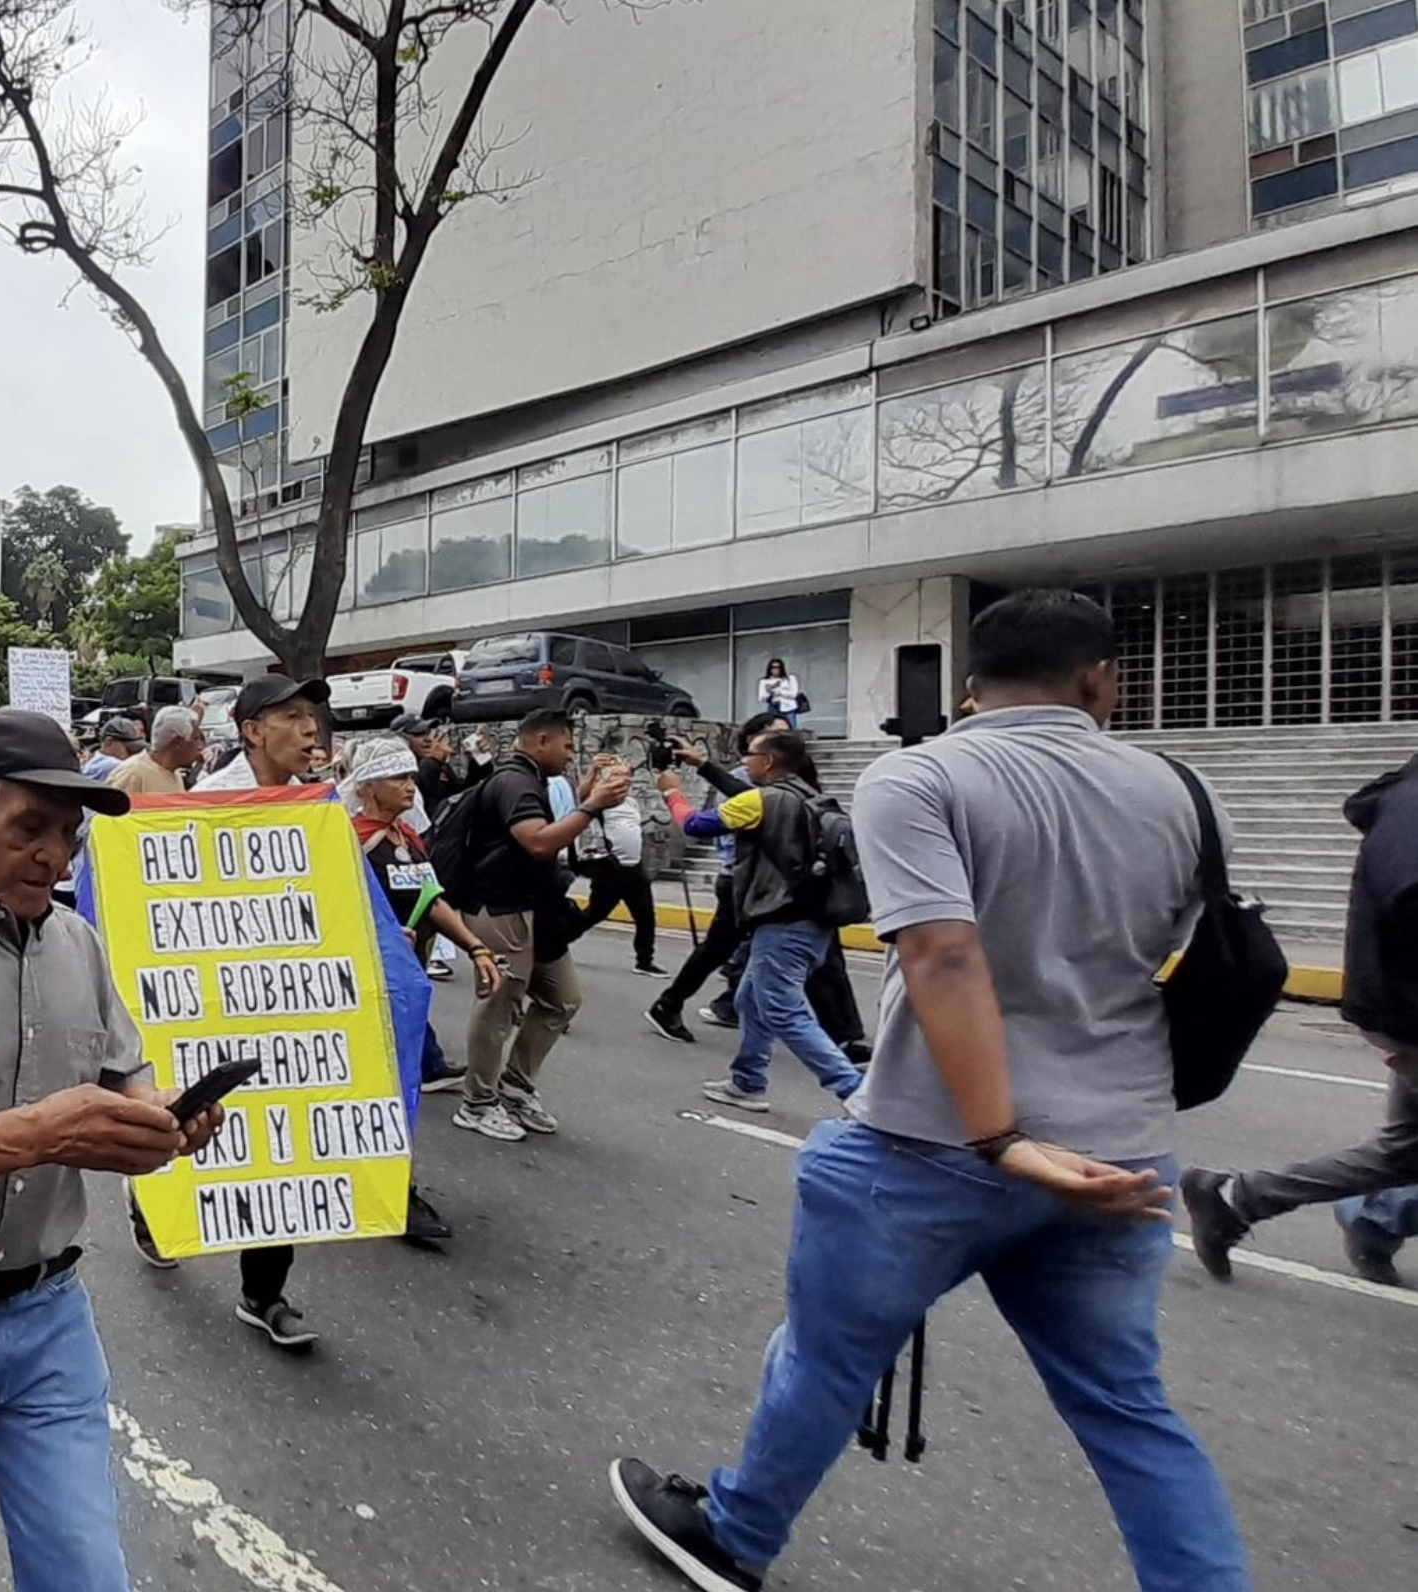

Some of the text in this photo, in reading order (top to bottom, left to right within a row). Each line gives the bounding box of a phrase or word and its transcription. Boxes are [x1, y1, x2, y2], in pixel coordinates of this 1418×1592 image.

[142, 823, 199, 881] ALÓ
[150, 885, 318, 949] EXTORSIÓN
[141, 960, 356, 1020] NOS ROBARON
[268, 1108, 286, 1160] Y
[313, 1102, 405, 1158] OTRAS
[199, 1177, 352, 1242] MINUCIAS
